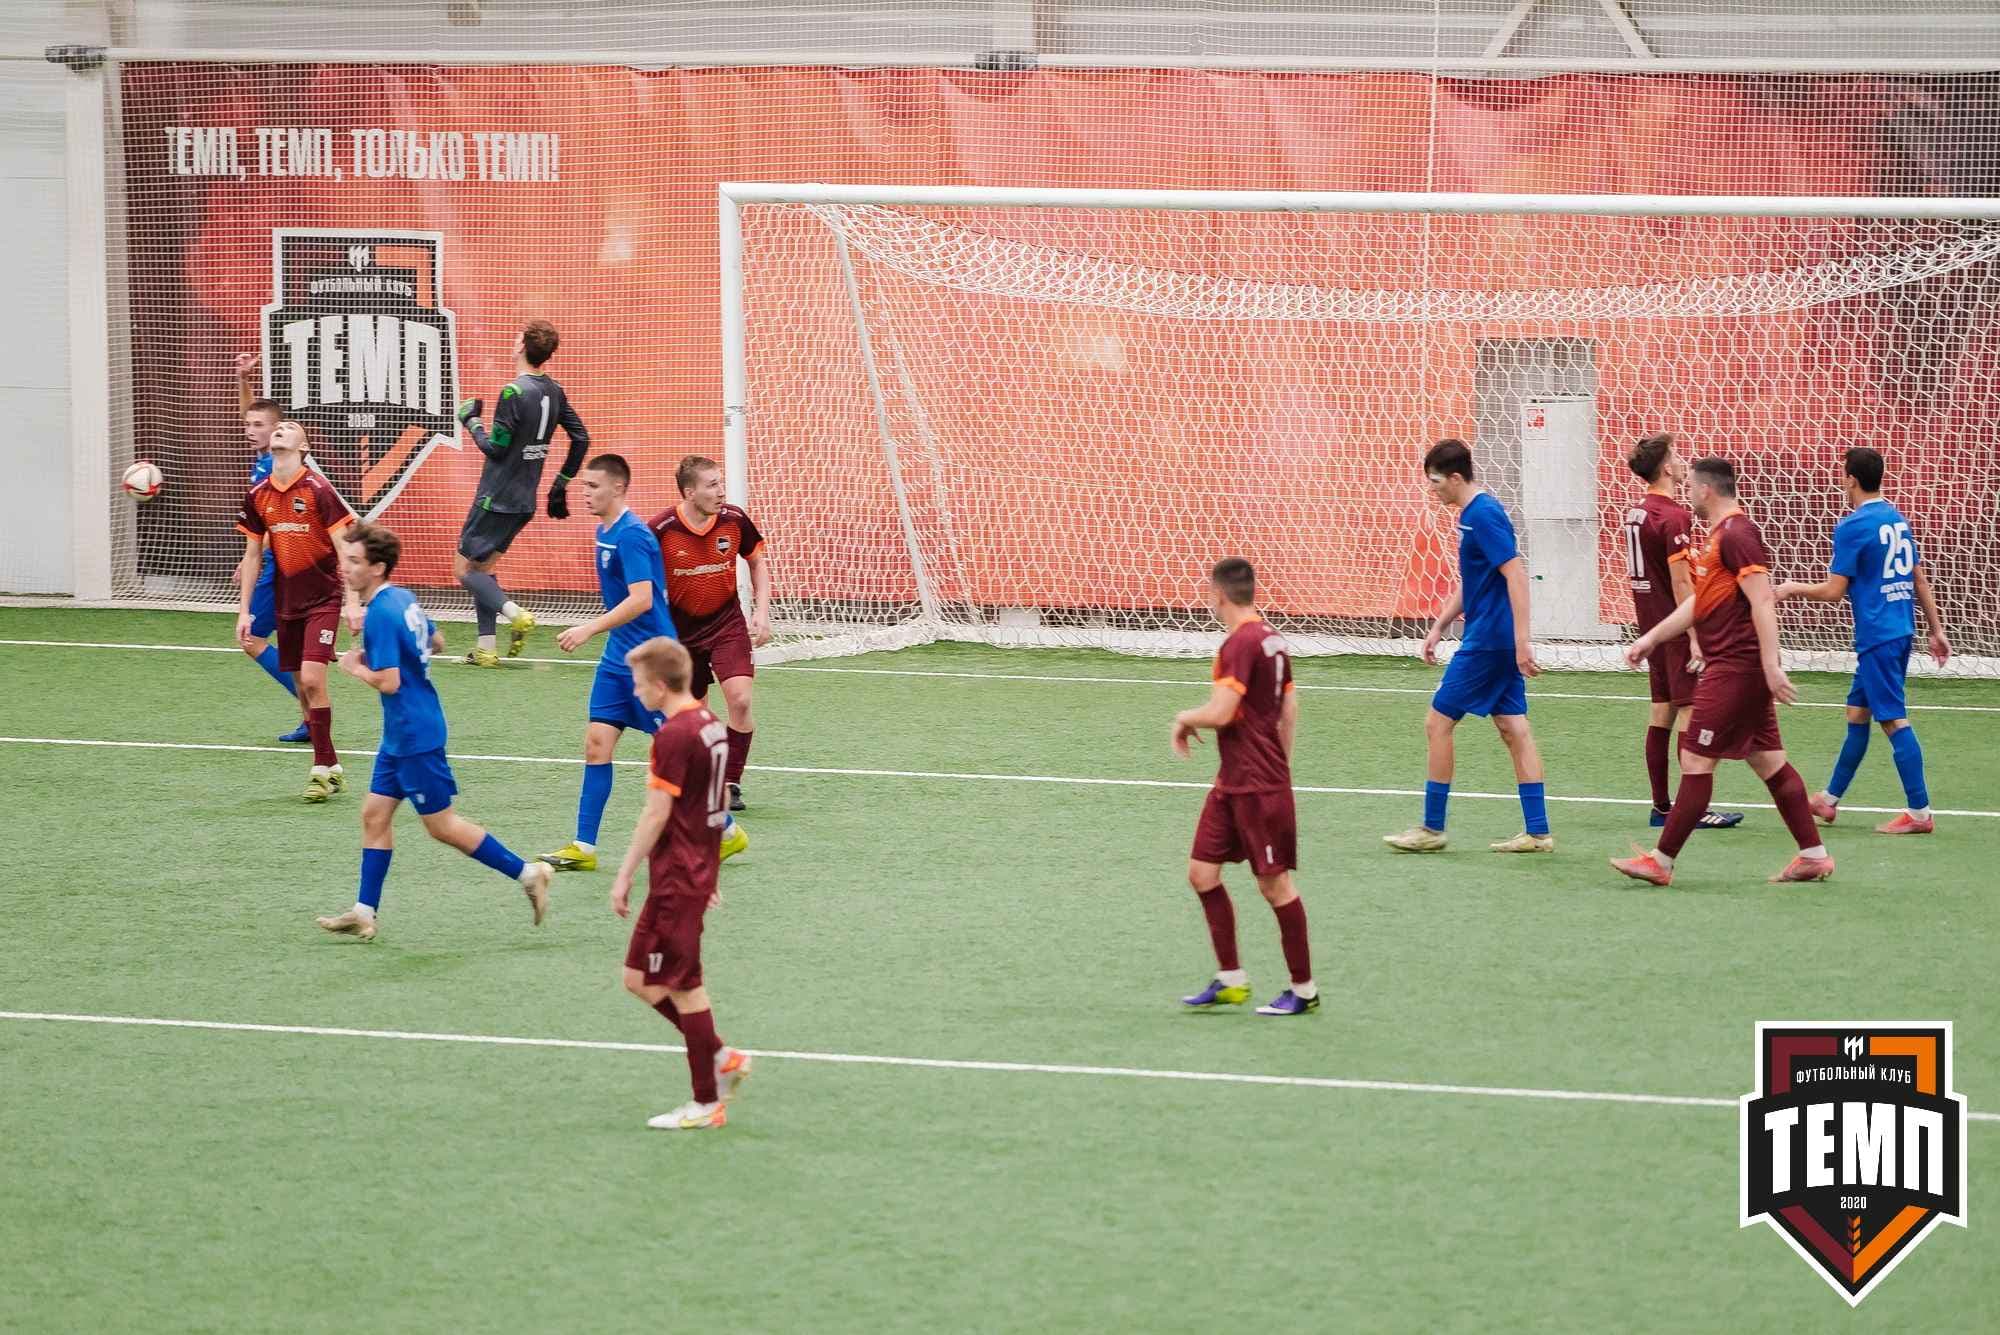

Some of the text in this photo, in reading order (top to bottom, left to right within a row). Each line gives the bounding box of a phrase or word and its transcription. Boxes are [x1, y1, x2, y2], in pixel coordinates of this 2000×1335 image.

[165, 127, 560, 183] ТЕМП, ТЕМП, ТОЛЬКО ТЕМП!
[283, 314, 441, 416] ТЕМП
[536, 395, 551, 440] 1
[1625, 524, 1645, 578] 11
[1879, 522, 1914, 579] 25
